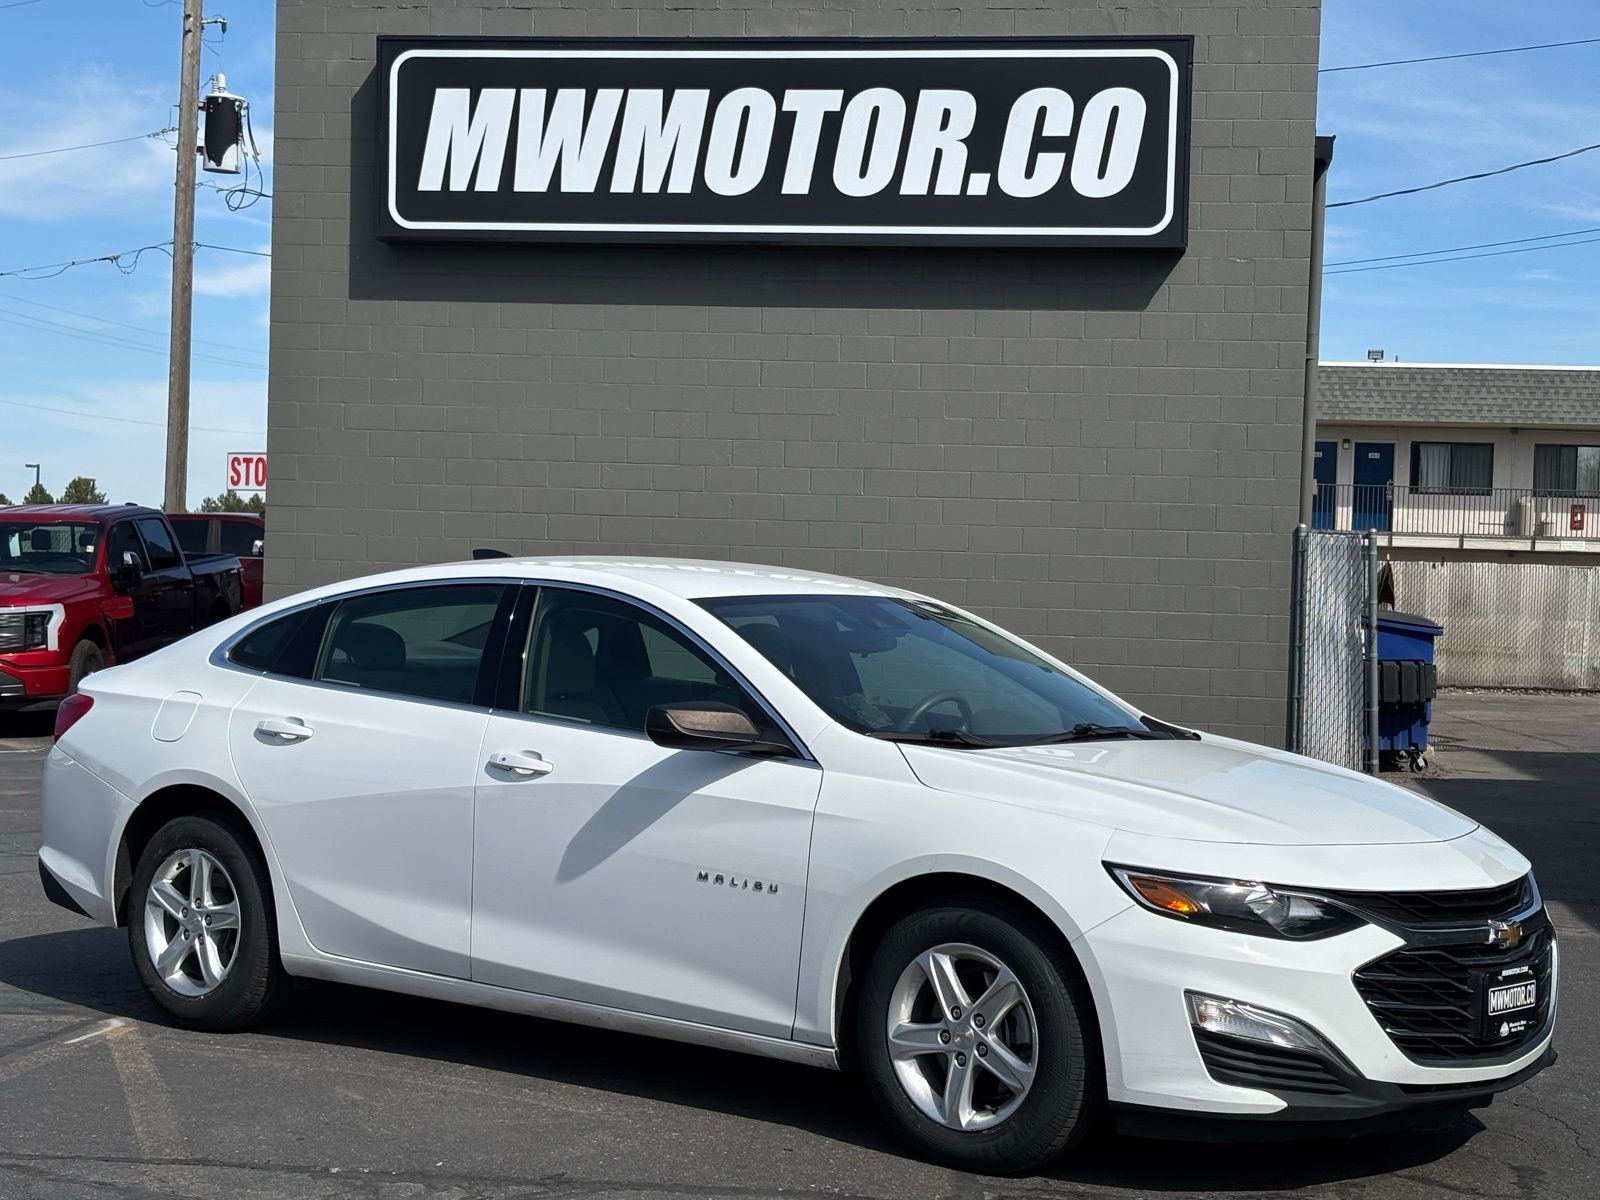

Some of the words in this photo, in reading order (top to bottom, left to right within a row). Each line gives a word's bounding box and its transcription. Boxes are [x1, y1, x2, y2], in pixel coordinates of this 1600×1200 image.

[417, 86, 1148, 199] MWMOTOR.CO
[696, 870, 779, 894] MALIBU
[1490, 984, 1535, 1012] MWMOTOR.CO
